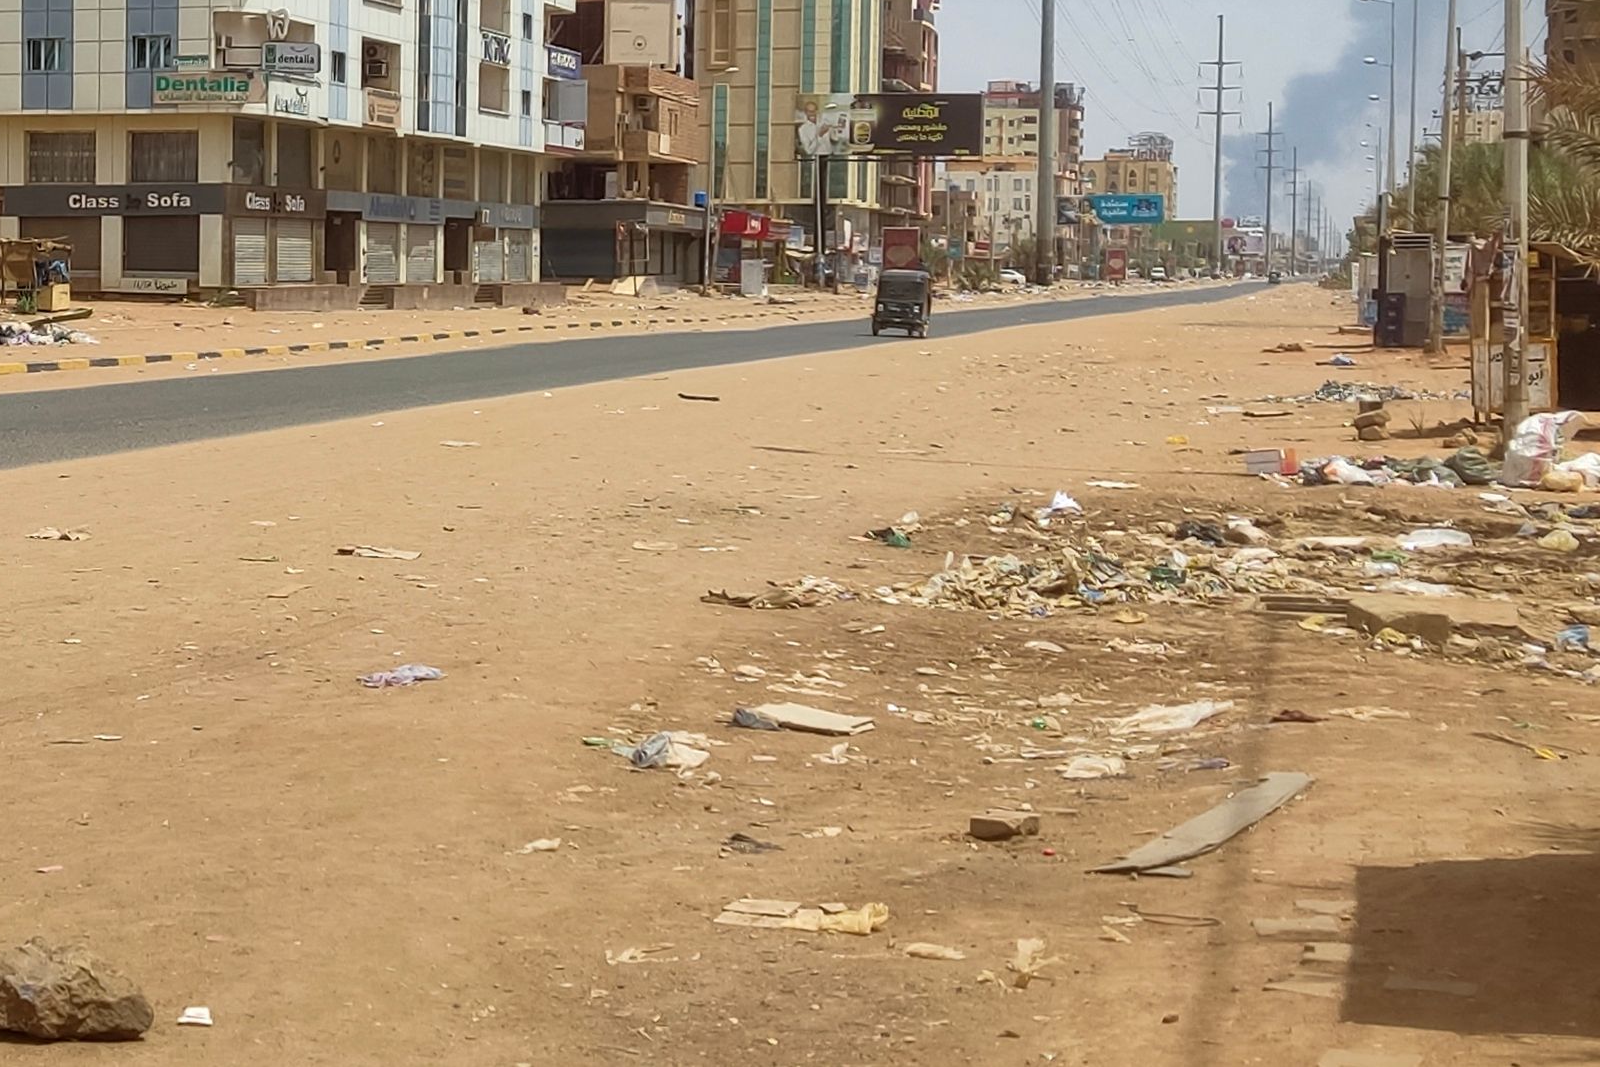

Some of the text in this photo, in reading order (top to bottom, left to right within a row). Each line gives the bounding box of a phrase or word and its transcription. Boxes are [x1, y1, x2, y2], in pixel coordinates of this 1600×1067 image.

[278, 54, 315, 64] dentalia
[155, 75, 250, 93] Dentalia
[68, 192, 191, 209] Class Sofa
[245, 191, 306, 212] Class Sofa
